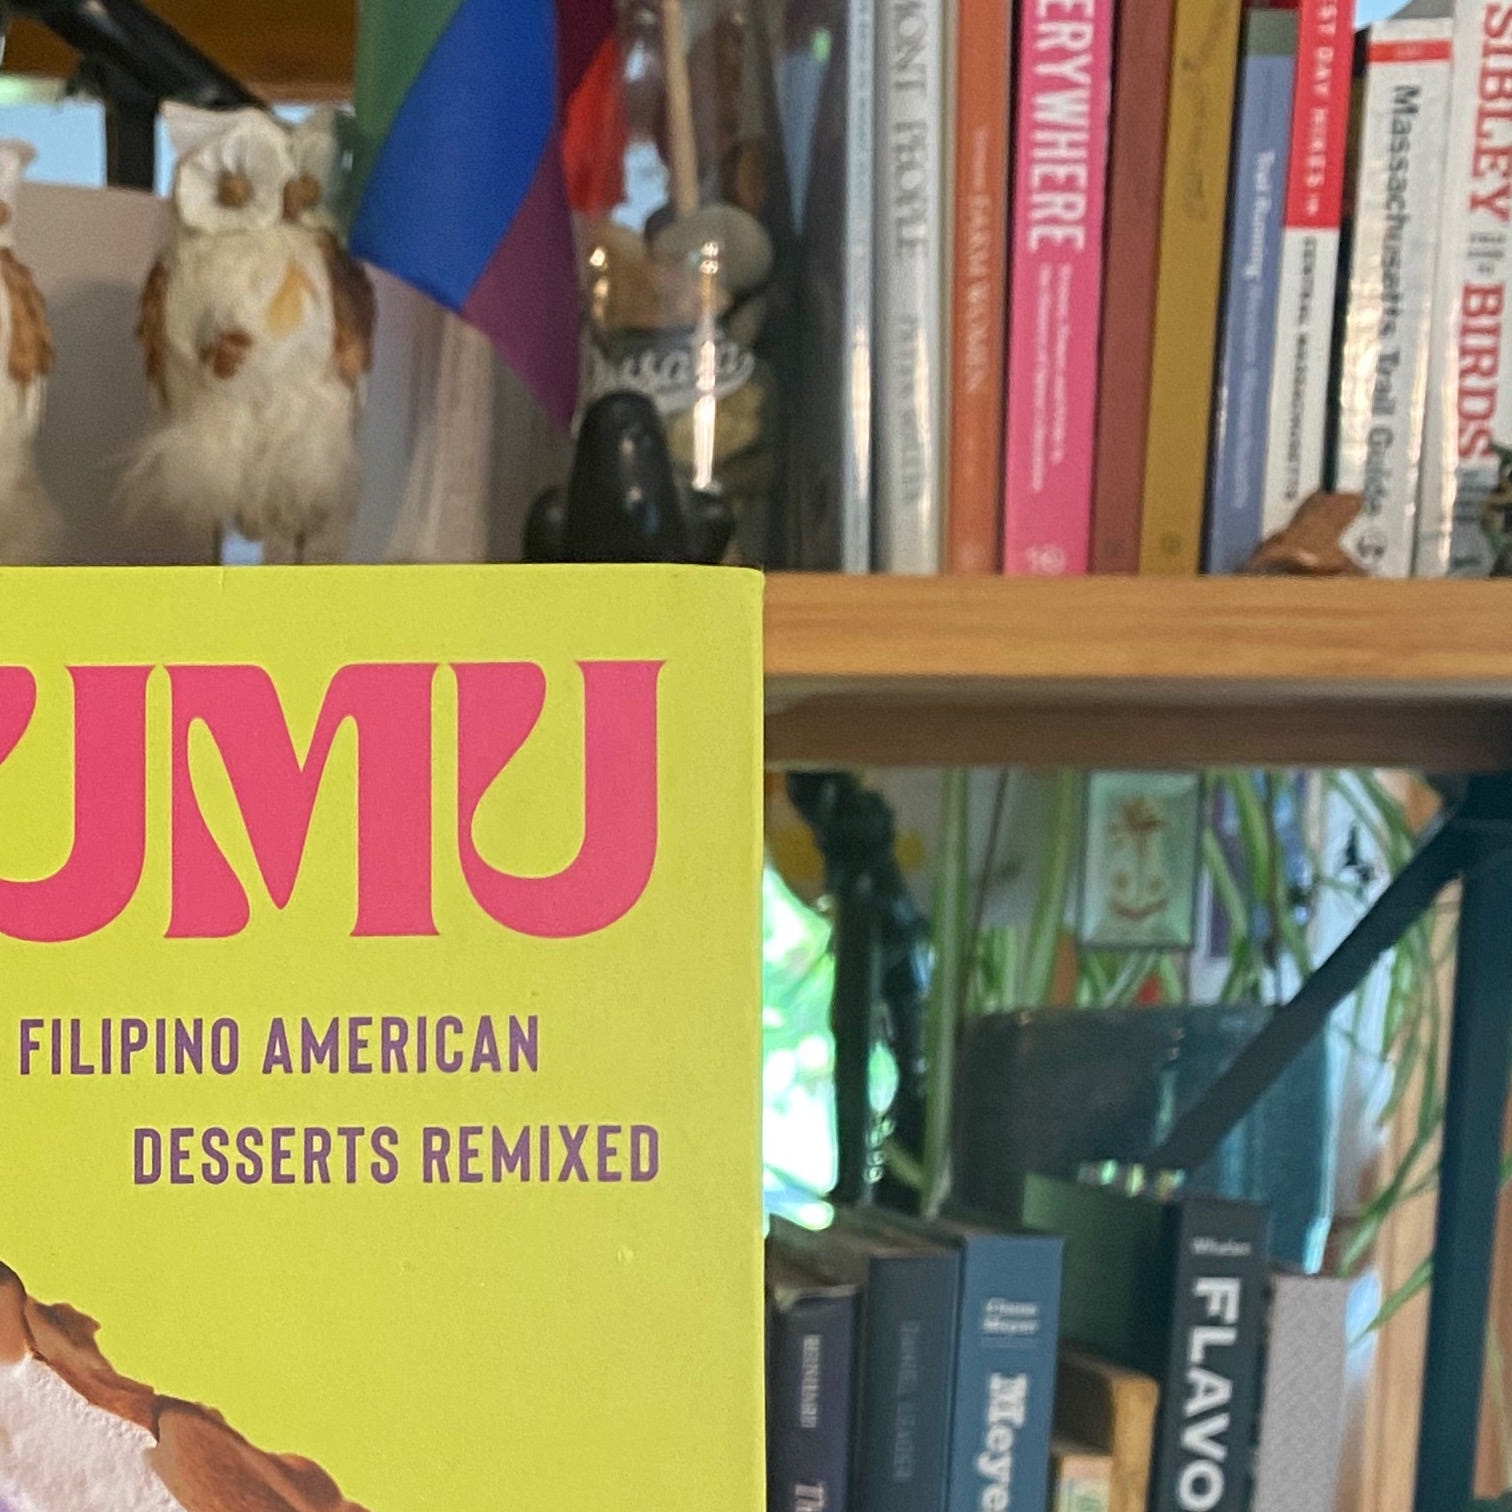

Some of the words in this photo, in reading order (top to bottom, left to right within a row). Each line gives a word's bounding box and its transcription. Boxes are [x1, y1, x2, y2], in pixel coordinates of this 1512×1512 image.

[1029, 0, 1094, 253] ERYWHERE
[1313, 45, 1335, 99] DAY
[1469, 2, 1512, 223] SIBLEY
[1380, 84, 1422, 336] Massachusetts
[1456, 281, 1506, 460] BIRDS
[19, 1017, 239, 1076] FILIPINO
[261, 1014, 540, 1074] AMERICAN
[132, 1125, 400, 1185] DESSERTS
[422, 1123, 661, 1183] REMIXED
